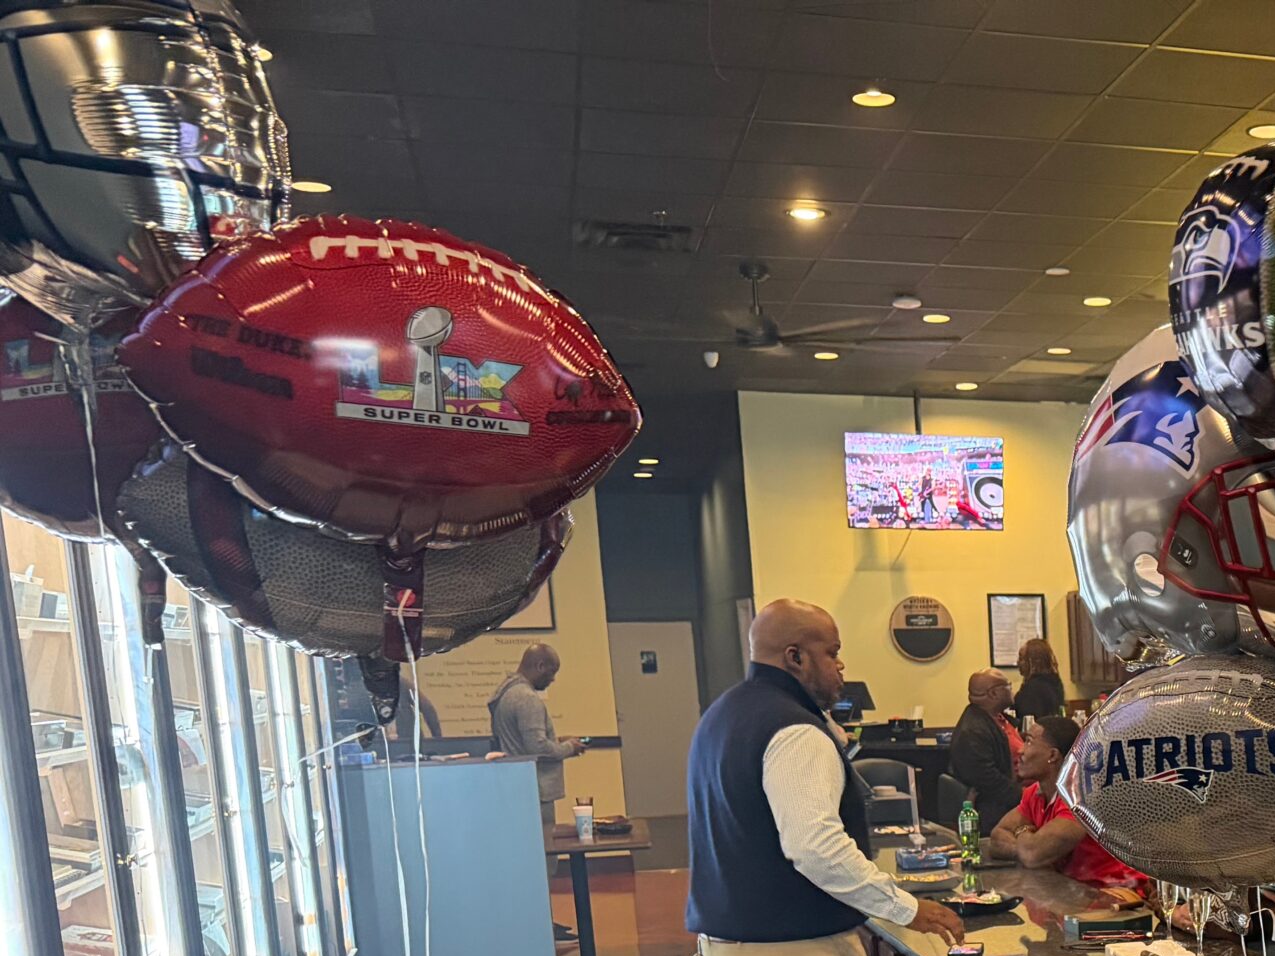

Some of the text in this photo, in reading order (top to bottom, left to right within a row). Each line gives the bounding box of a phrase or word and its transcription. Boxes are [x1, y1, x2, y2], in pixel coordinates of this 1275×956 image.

[1172, 302, 1227, 326] EATTLE
[19, 384, 66, 397] SUPE
[363, 406, 509, 431] SUPER BOWL
